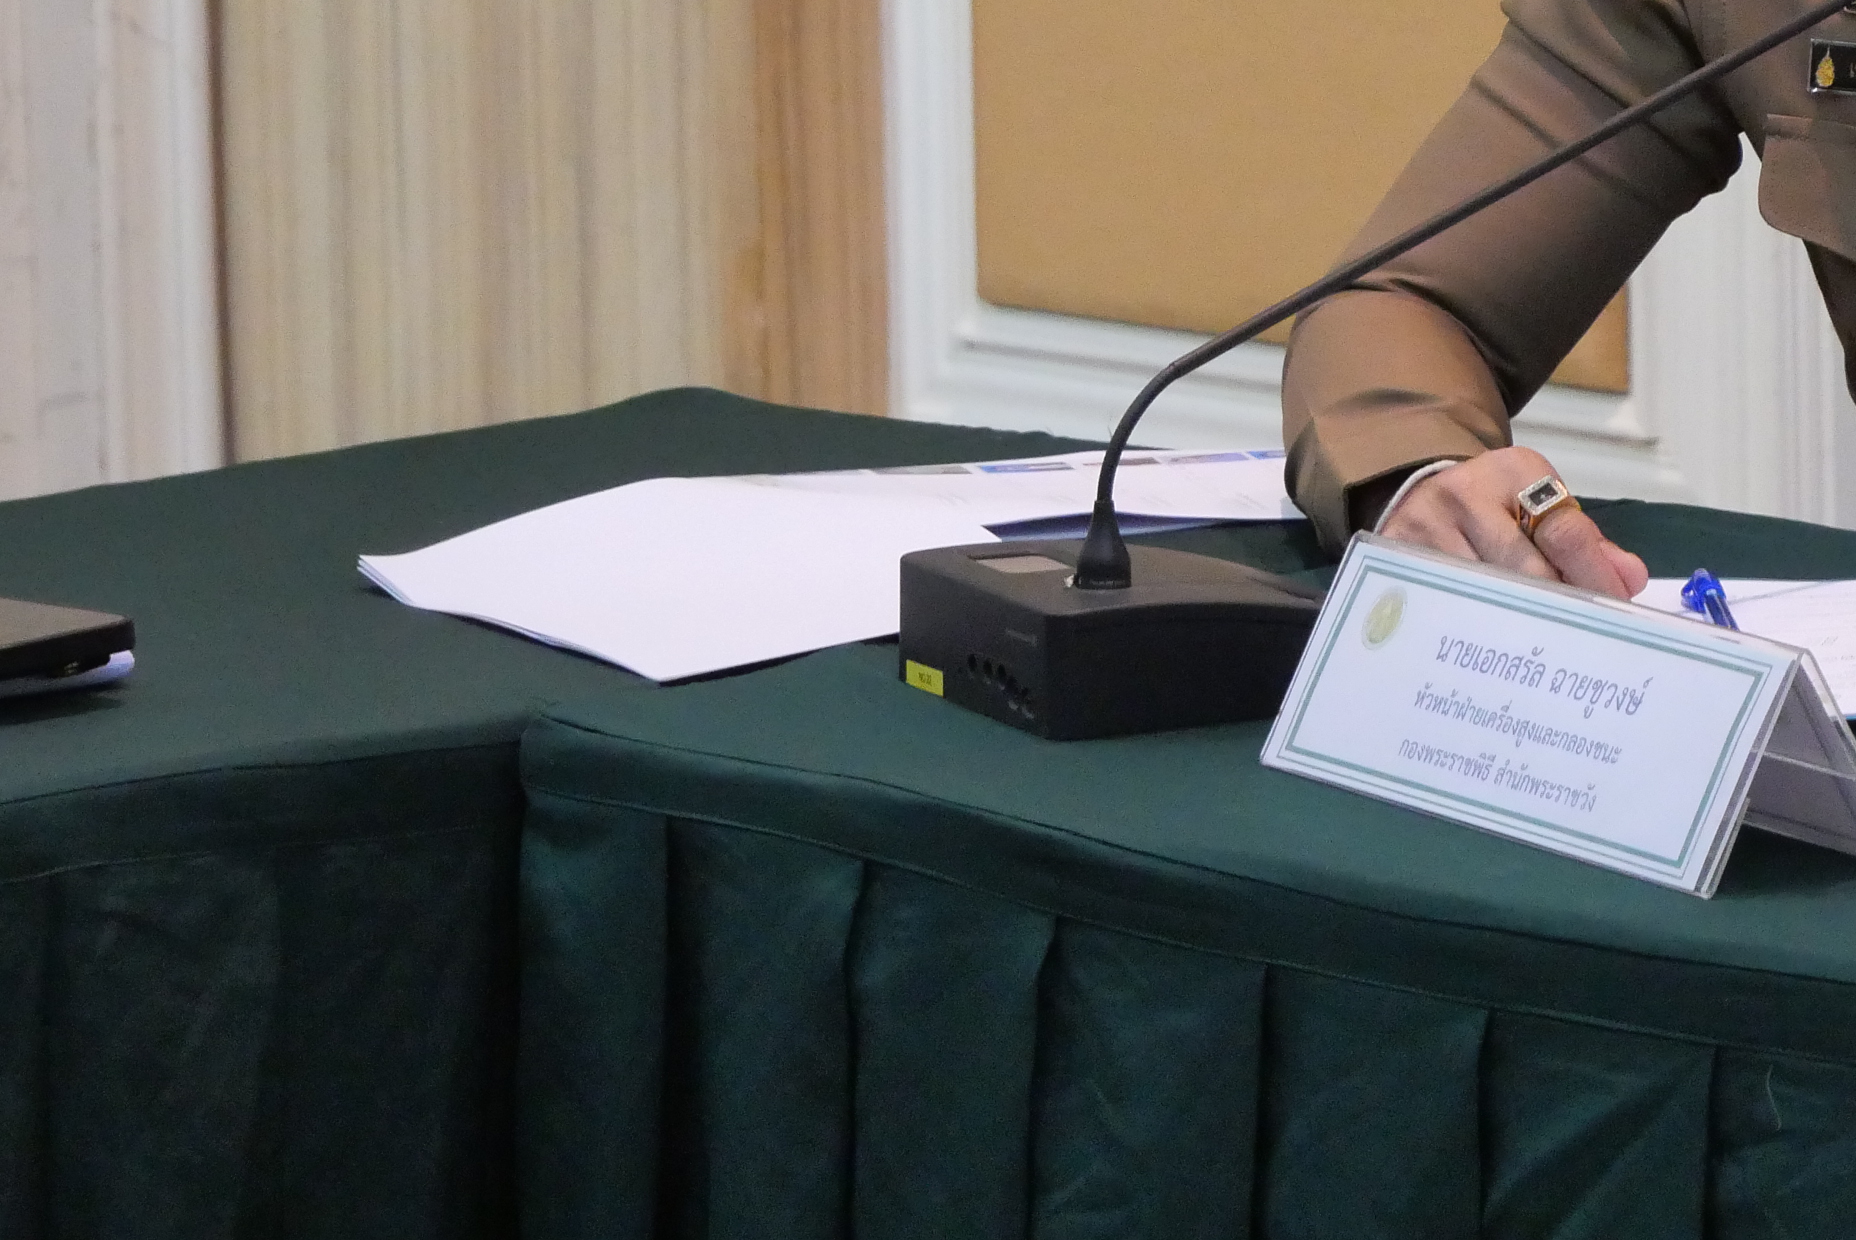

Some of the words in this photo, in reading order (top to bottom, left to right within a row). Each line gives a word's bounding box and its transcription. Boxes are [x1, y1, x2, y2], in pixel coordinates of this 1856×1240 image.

[1435, 635, 1547, 689] นายเอกสรัล
[1549, 667, 1654, 720] ฉายชูวงษ์
[1414, 681, 1623, 764] หัวหน้าฝ่ายเครื่องสูงและกลองชนะ
[1398, 738, 1497, 781] กองพระราชพิธี
[1494, 759, 1597, 812] สำนักพระราชวัง
